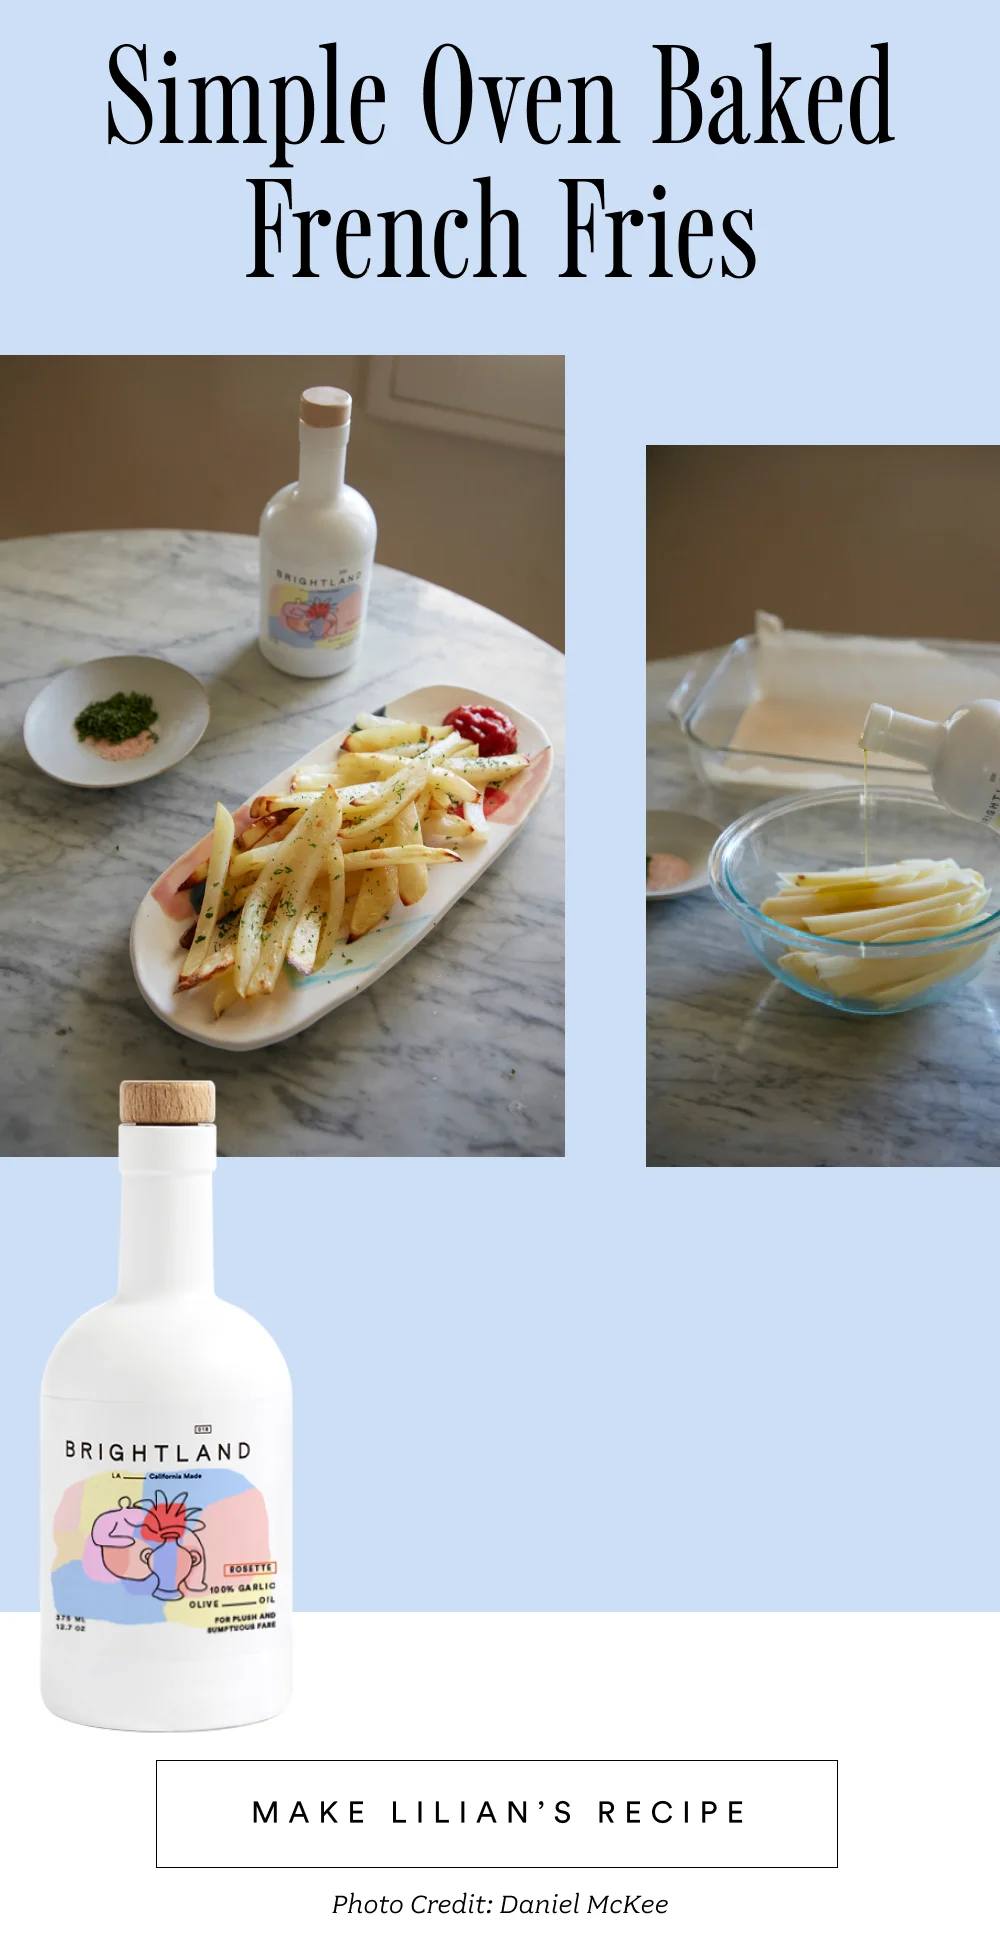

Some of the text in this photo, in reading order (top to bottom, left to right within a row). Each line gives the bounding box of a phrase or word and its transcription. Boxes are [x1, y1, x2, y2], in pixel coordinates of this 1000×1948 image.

[276, 569, 362, 587] BRIGHTLAND
[65, 1439, 251, 1463] BRIGHTLAND
[148, 1472, 182, 1480] California
[183, 1472, 202, 1480] Made
[229, 1563, 272, 1574] ROSETTE
[210, 1582, 276, 1594] 100% GARLIC
[189, 1596, 276, 1609] OLIVE OIL
[214, 1611, 276, 1624] FOR PLUSH AND
[56, 1623, 72, 1631] 12.7
[207, 1621, 276, 1634] SUMPTUOUS FARE
